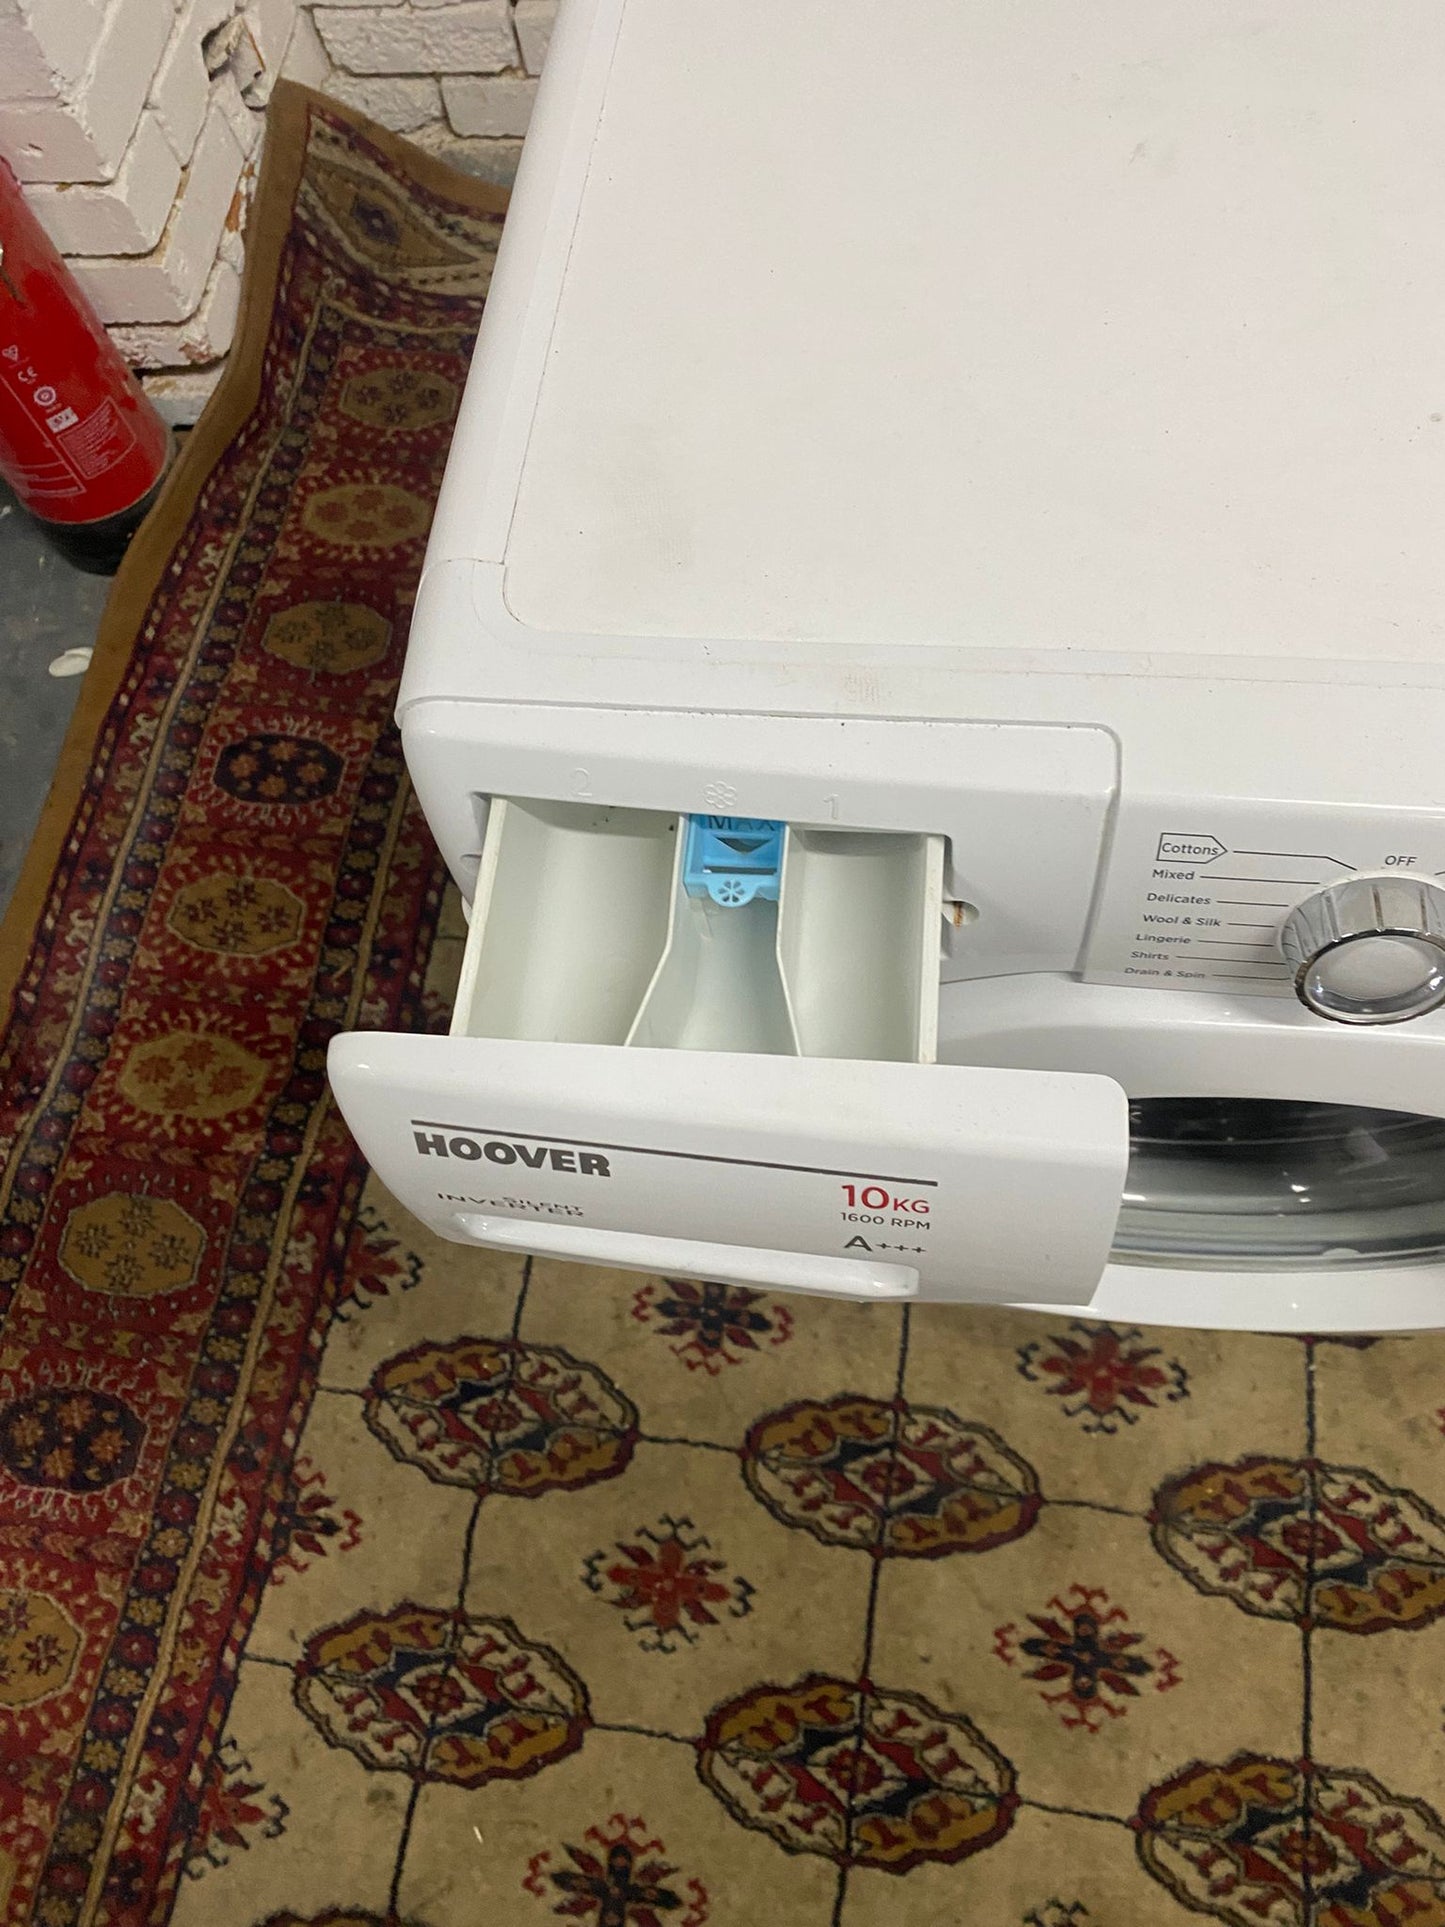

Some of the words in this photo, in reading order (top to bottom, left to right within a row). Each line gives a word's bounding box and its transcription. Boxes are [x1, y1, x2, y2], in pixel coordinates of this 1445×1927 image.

[707, 815, 776, 831] MAX
[1161, 842, 1220, 856] Cottons
[1384, 855, 1417, 867] OFF
[1152, 868, 1195, 881] Mixed
[1146, 892, 1211, 905] Delicates
[1142, 914, 1179, 925] Wool
[1182, 916, 1193, 926] &
[1195, 917, 1222, 927] Silk
[1135, 933, 1191, 945] Lingerie
[1131, 951, 1169, 961] Shirts
[1124, 967, 1160, 977] Drain
[1163, 969, 1173, 978] &
[1176, 971, 1206, 980] Spin
[413, 1131, 611, 1177] HOOVER
[840, 1211, 885, 1225] 1600
[890, 1217, 930, 1230] RPM
